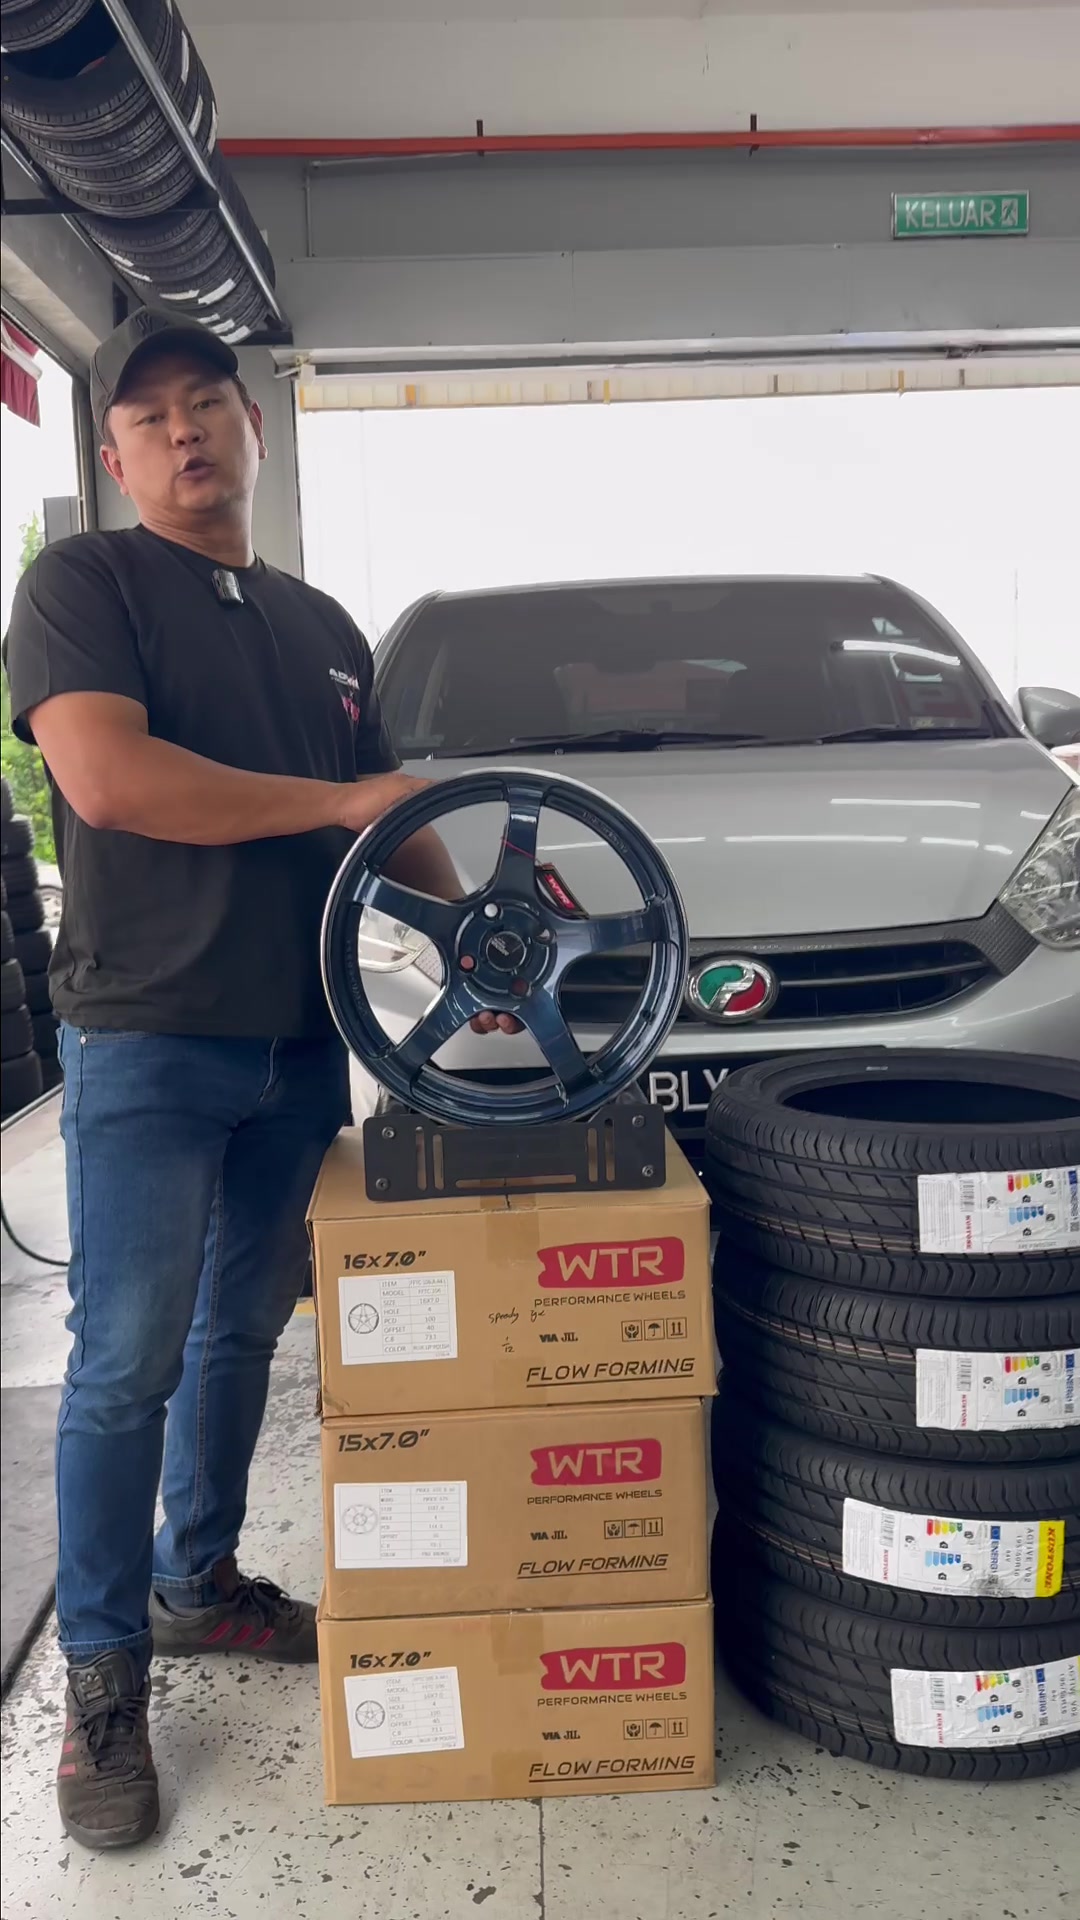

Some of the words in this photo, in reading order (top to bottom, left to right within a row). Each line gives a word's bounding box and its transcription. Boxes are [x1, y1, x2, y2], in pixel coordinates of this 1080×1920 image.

[905, 199, 997, 229] KELUAR
[548, 877, 573, 906] WTR
[557, 1245, 665, 1282] WTR
[534, 1294, 630, 1308] PERFORMANCE
[633, 1290, 686, 1301] WHEELS
[526, 1364, 590, 1383] FLOW
[594, 1357, 696, 1378] FORMING
[548, 1446, 643, 1480] WTR
[527, 1492, 613, 1505] PERFORMANCE
[615, 1489, 662, 1501] WHEELS
[518, 1559, 575, 1575] FLOW
[579, 1553, 669, 1572] FORMING
[1044, 1527, 1056, 1589] KUSTONE
[559, 1651, 665, 1683] WTR
[537, 1694, 633, 1707] PERFORMANCE
[635, 1691, 688, 1703] WHEELS
[529, 1761, 592, 1778] FLOW
[596, 1756, 695, 1774] FORMING
